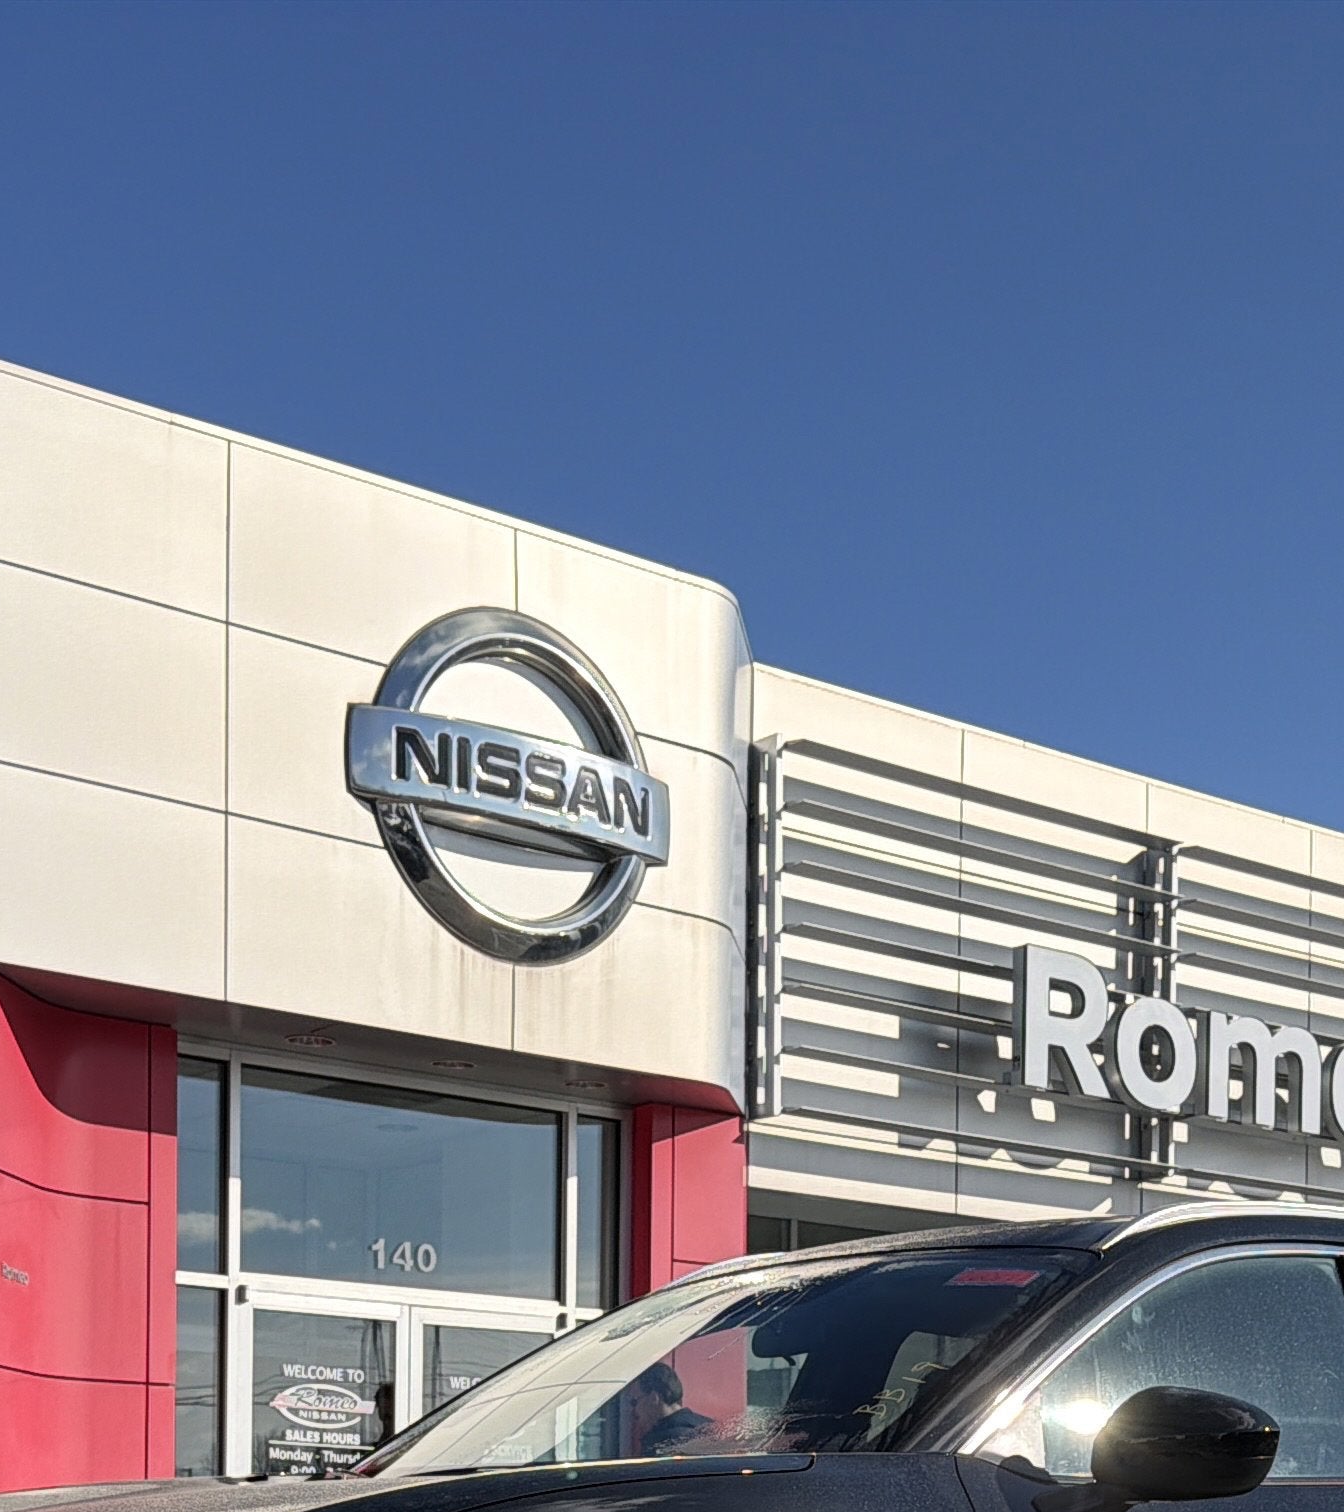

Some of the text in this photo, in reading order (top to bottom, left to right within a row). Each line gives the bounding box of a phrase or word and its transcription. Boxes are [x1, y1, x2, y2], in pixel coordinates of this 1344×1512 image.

[391, 725, 652, 842] NISSAN
[370, 1237, 437, 1273] 140
[282, 1363, 365, 1384] WELCOME TO
[449, 1375, 482, 1390] WELC
[289, 1387, 359, 1410] Romeo
[298, 1409, 347, 1422] NISSAN
[285, 1428, 361, 1446] SALES HOURS
[269, 1446, 314, 1464] Monday
[321, 1450, 362, 1464] Thursd
